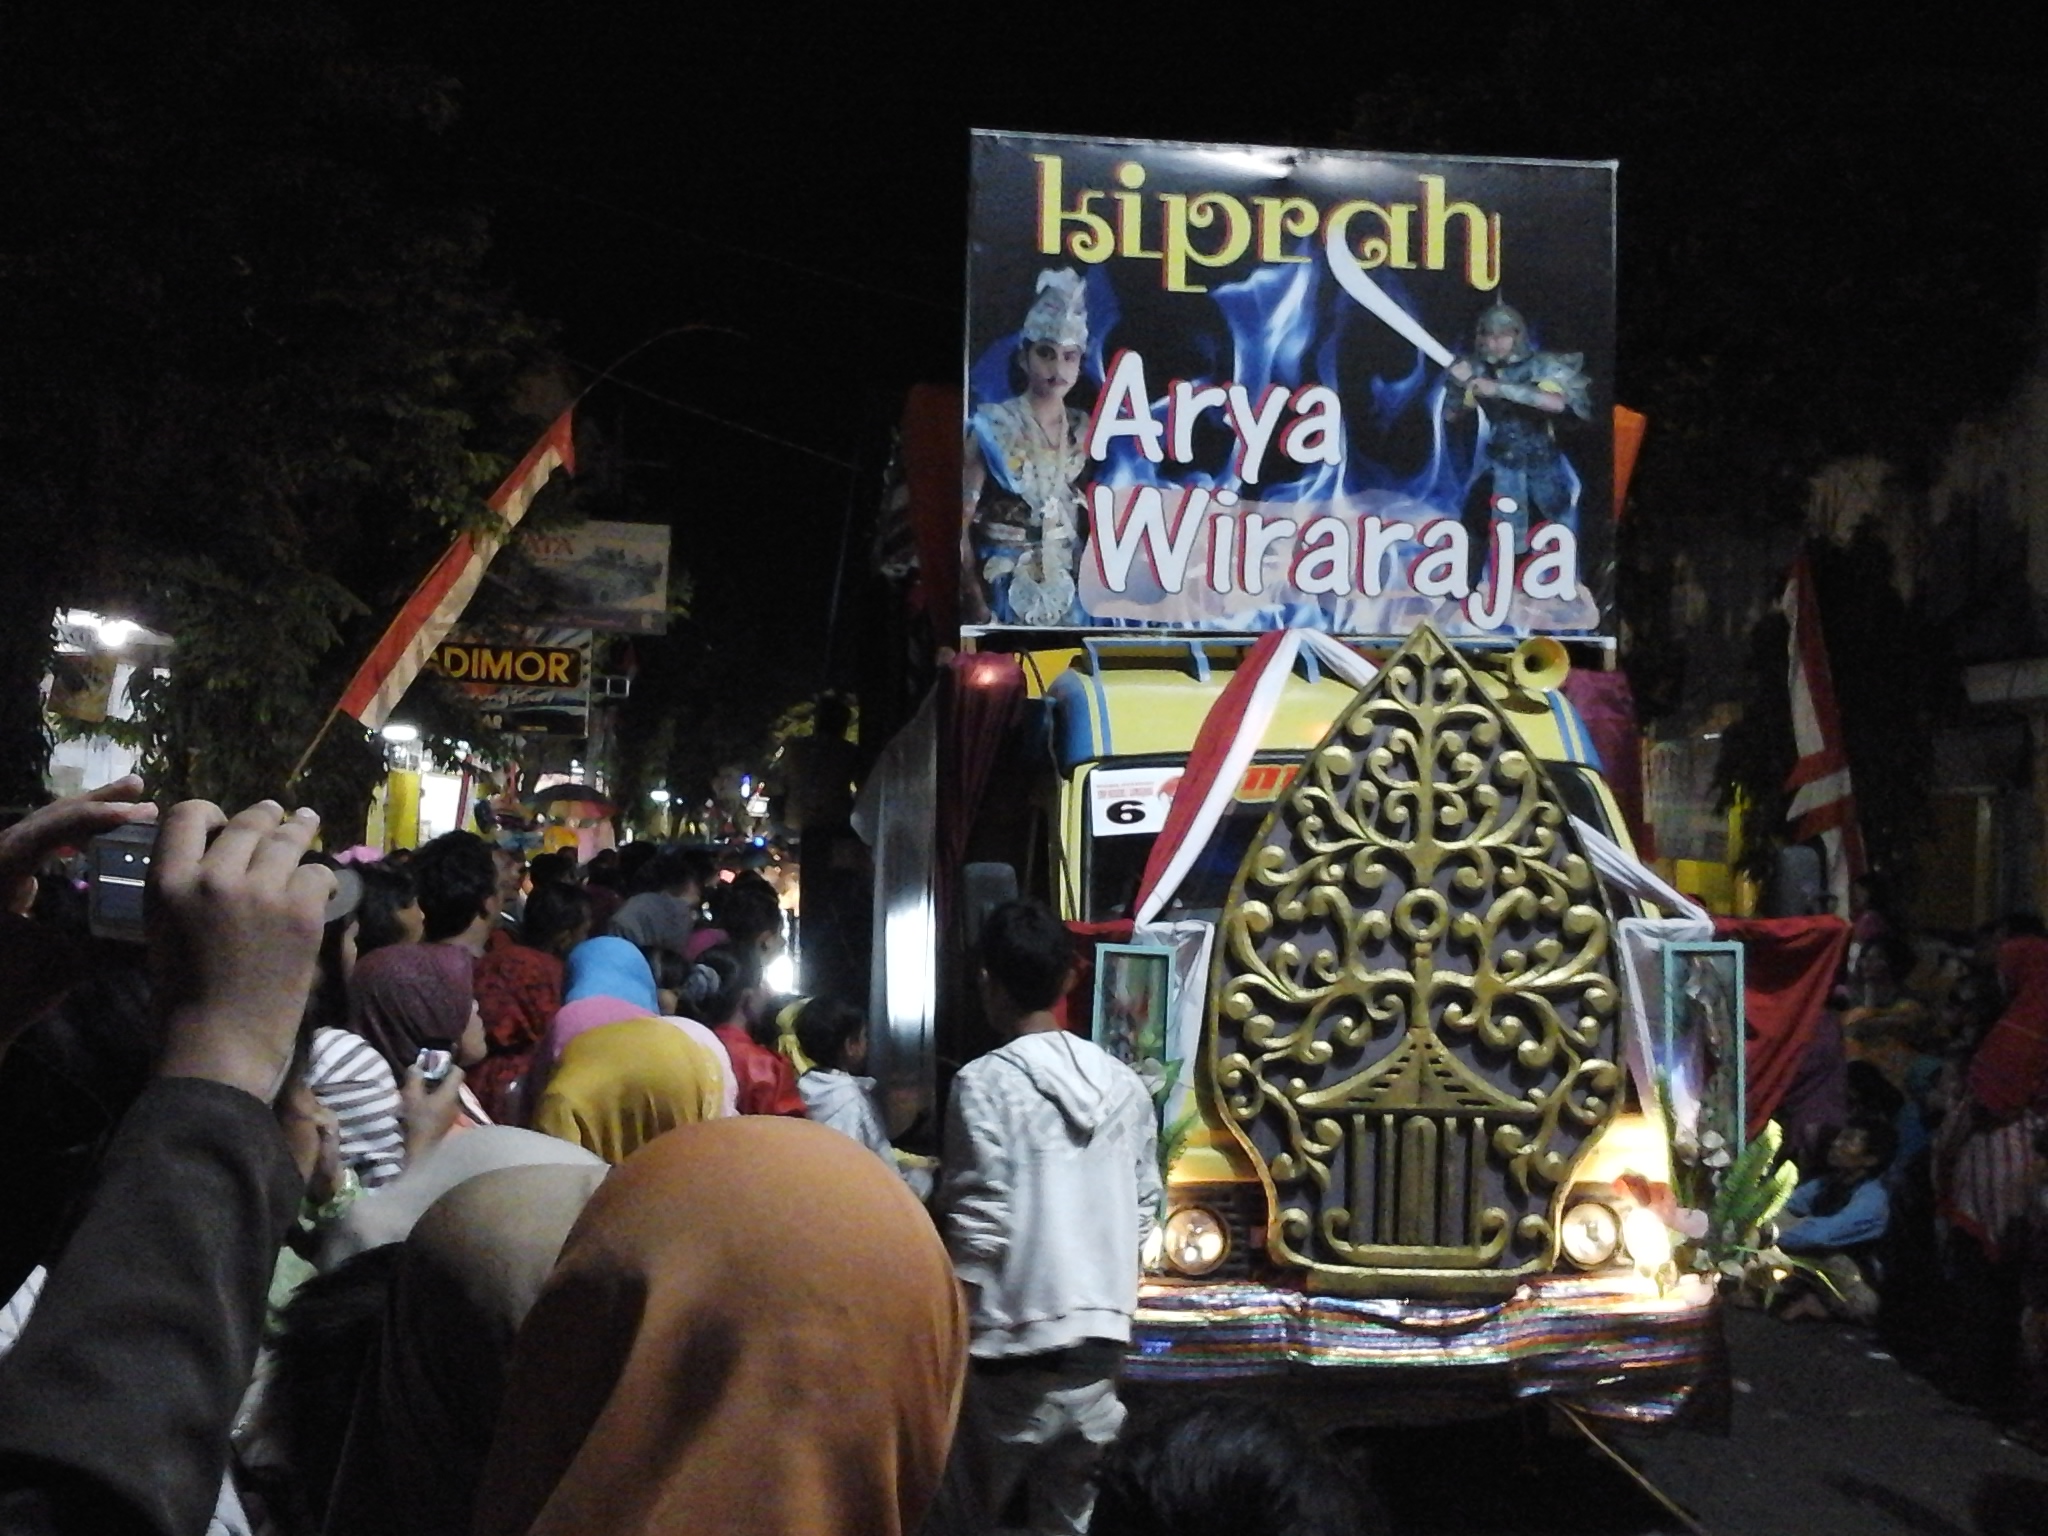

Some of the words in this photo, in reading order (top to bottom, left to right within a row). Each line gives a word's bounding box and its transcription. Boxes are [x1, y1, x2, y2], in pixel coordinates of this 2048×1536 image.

[1086, 348, 1343, 485] Arya
[1086, 481, 1580, 630] Wiraraja
[1106, 800, 1146, 824] 6
